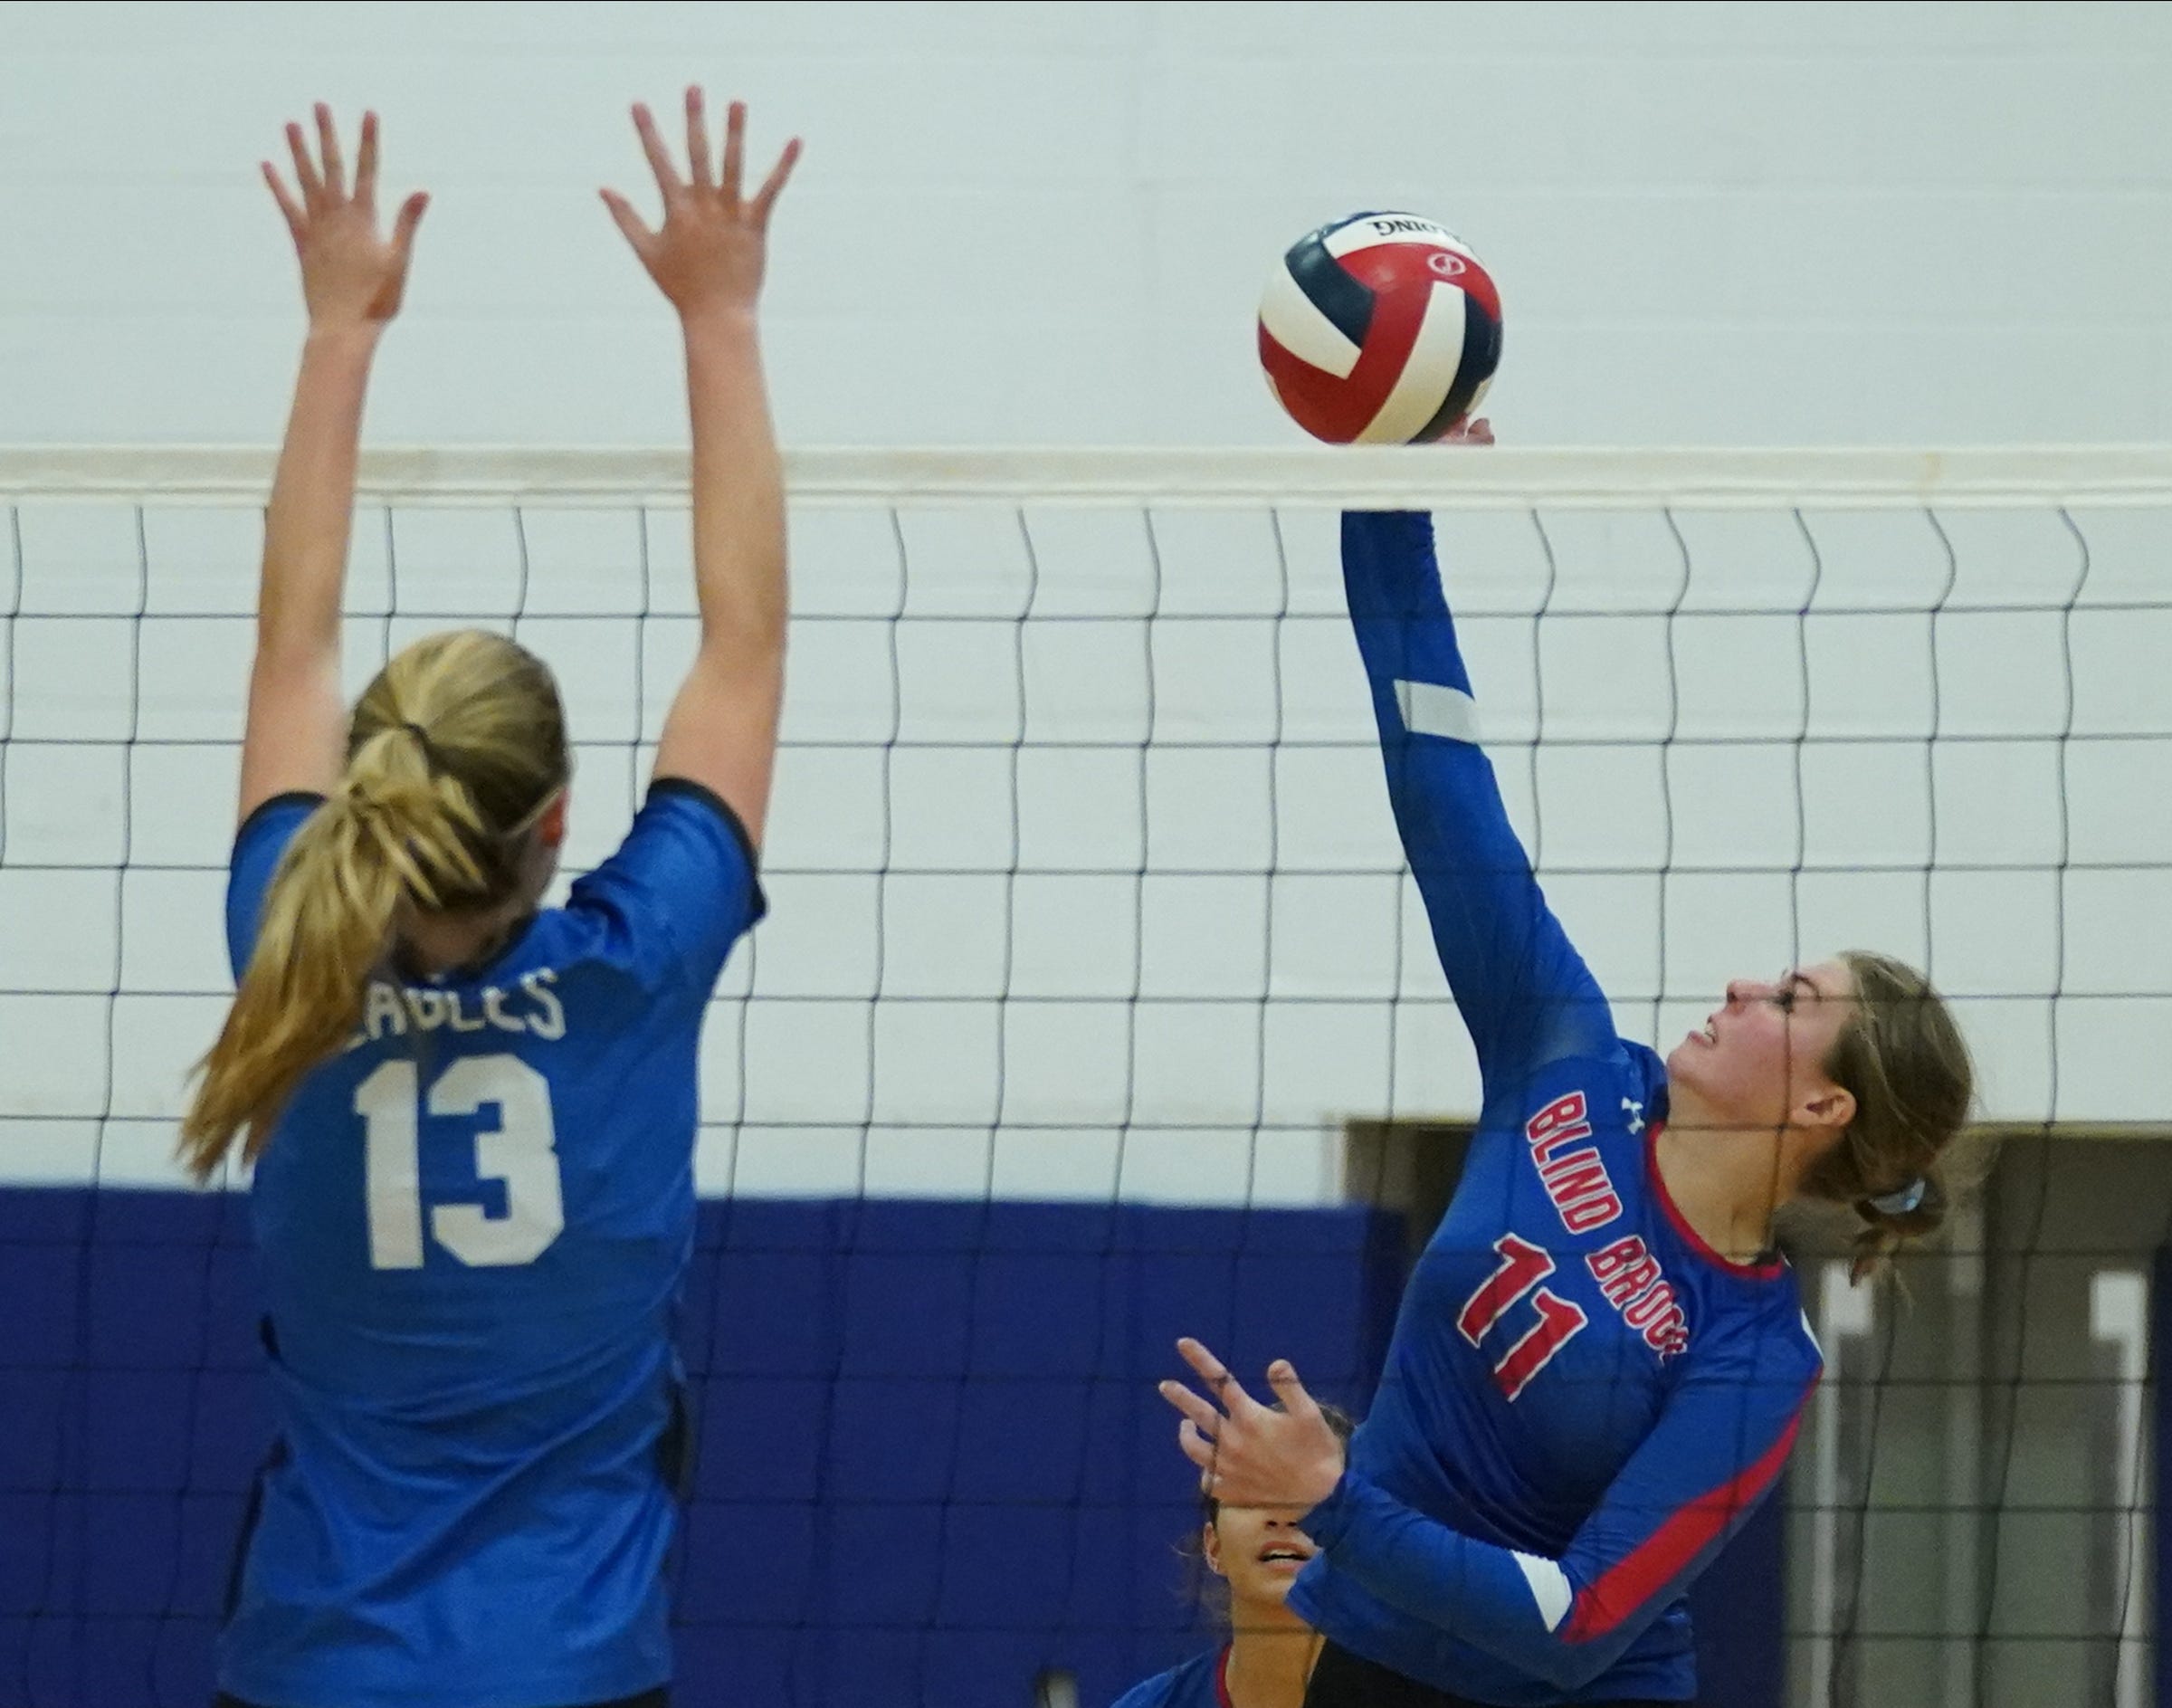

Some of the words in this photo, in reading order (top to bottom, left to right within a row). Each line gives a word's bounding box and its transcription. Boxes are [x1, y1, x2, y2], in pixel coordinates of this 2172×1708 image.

[353, 1053, 566, 1269] 13
[1526, 1091, 1623, 1235] BLIND
[1457, 1232, 1588, 1402] 11
